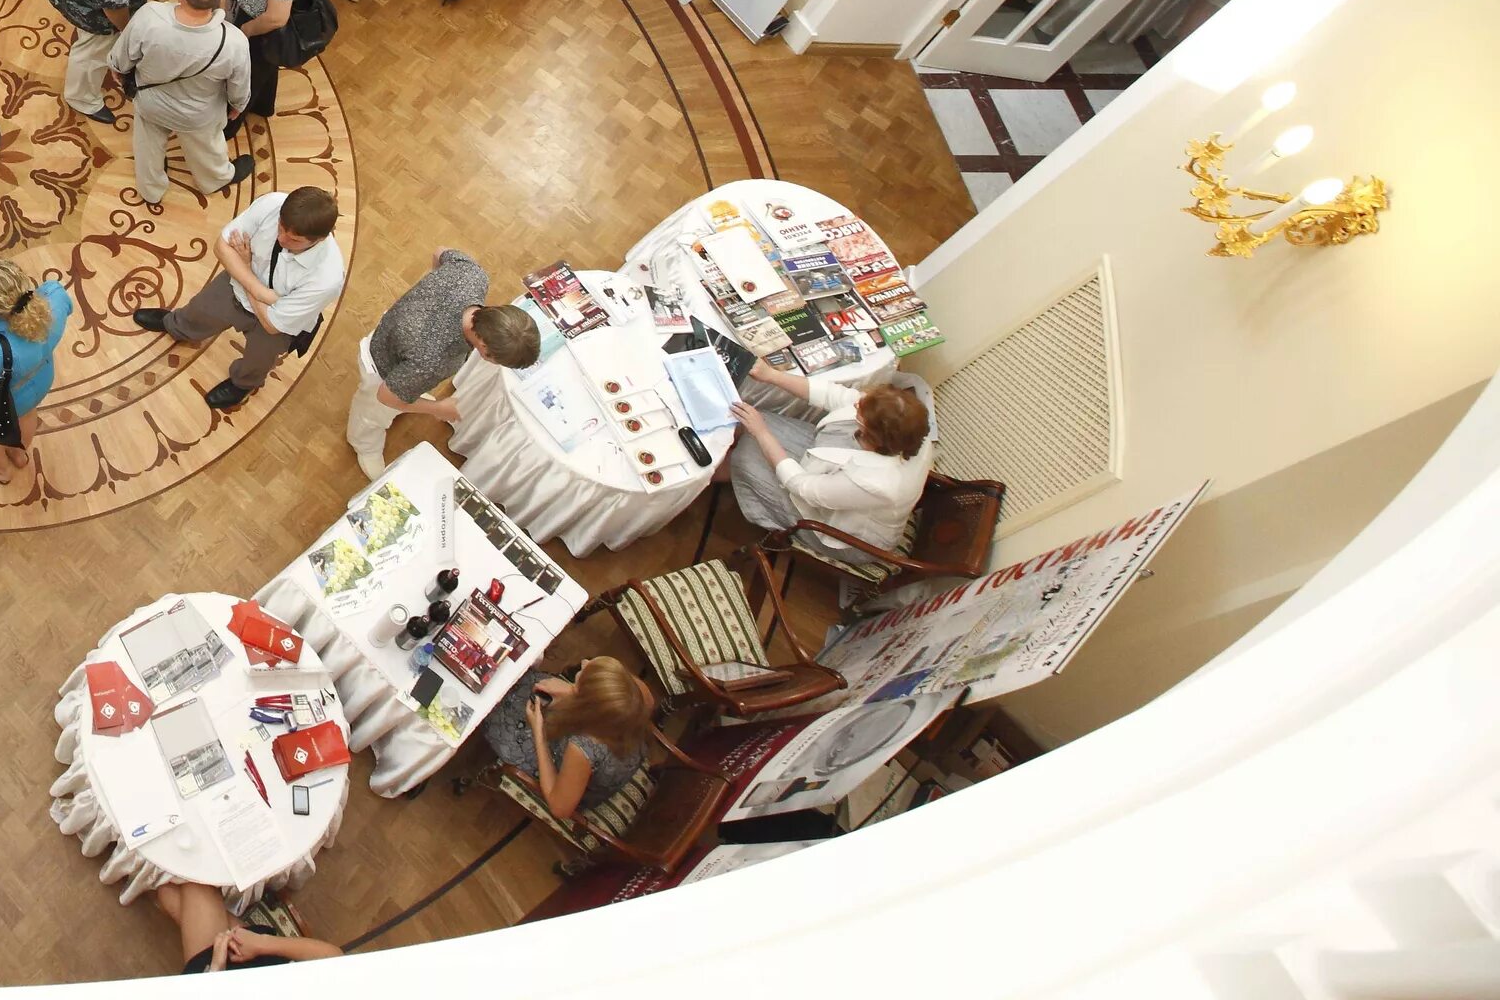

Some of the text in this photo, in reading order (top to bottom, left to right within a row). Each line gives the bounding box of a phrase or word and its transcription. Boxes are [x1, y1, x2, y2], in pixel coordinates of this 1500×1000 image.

[823, 221, 865, 242] МЯСО
[867, 285, 912, 303] ВЫПЕЧКА
[884, 315, 929, 337] САЛАТЫ
[439, 493, 448, 550] Фанагория
